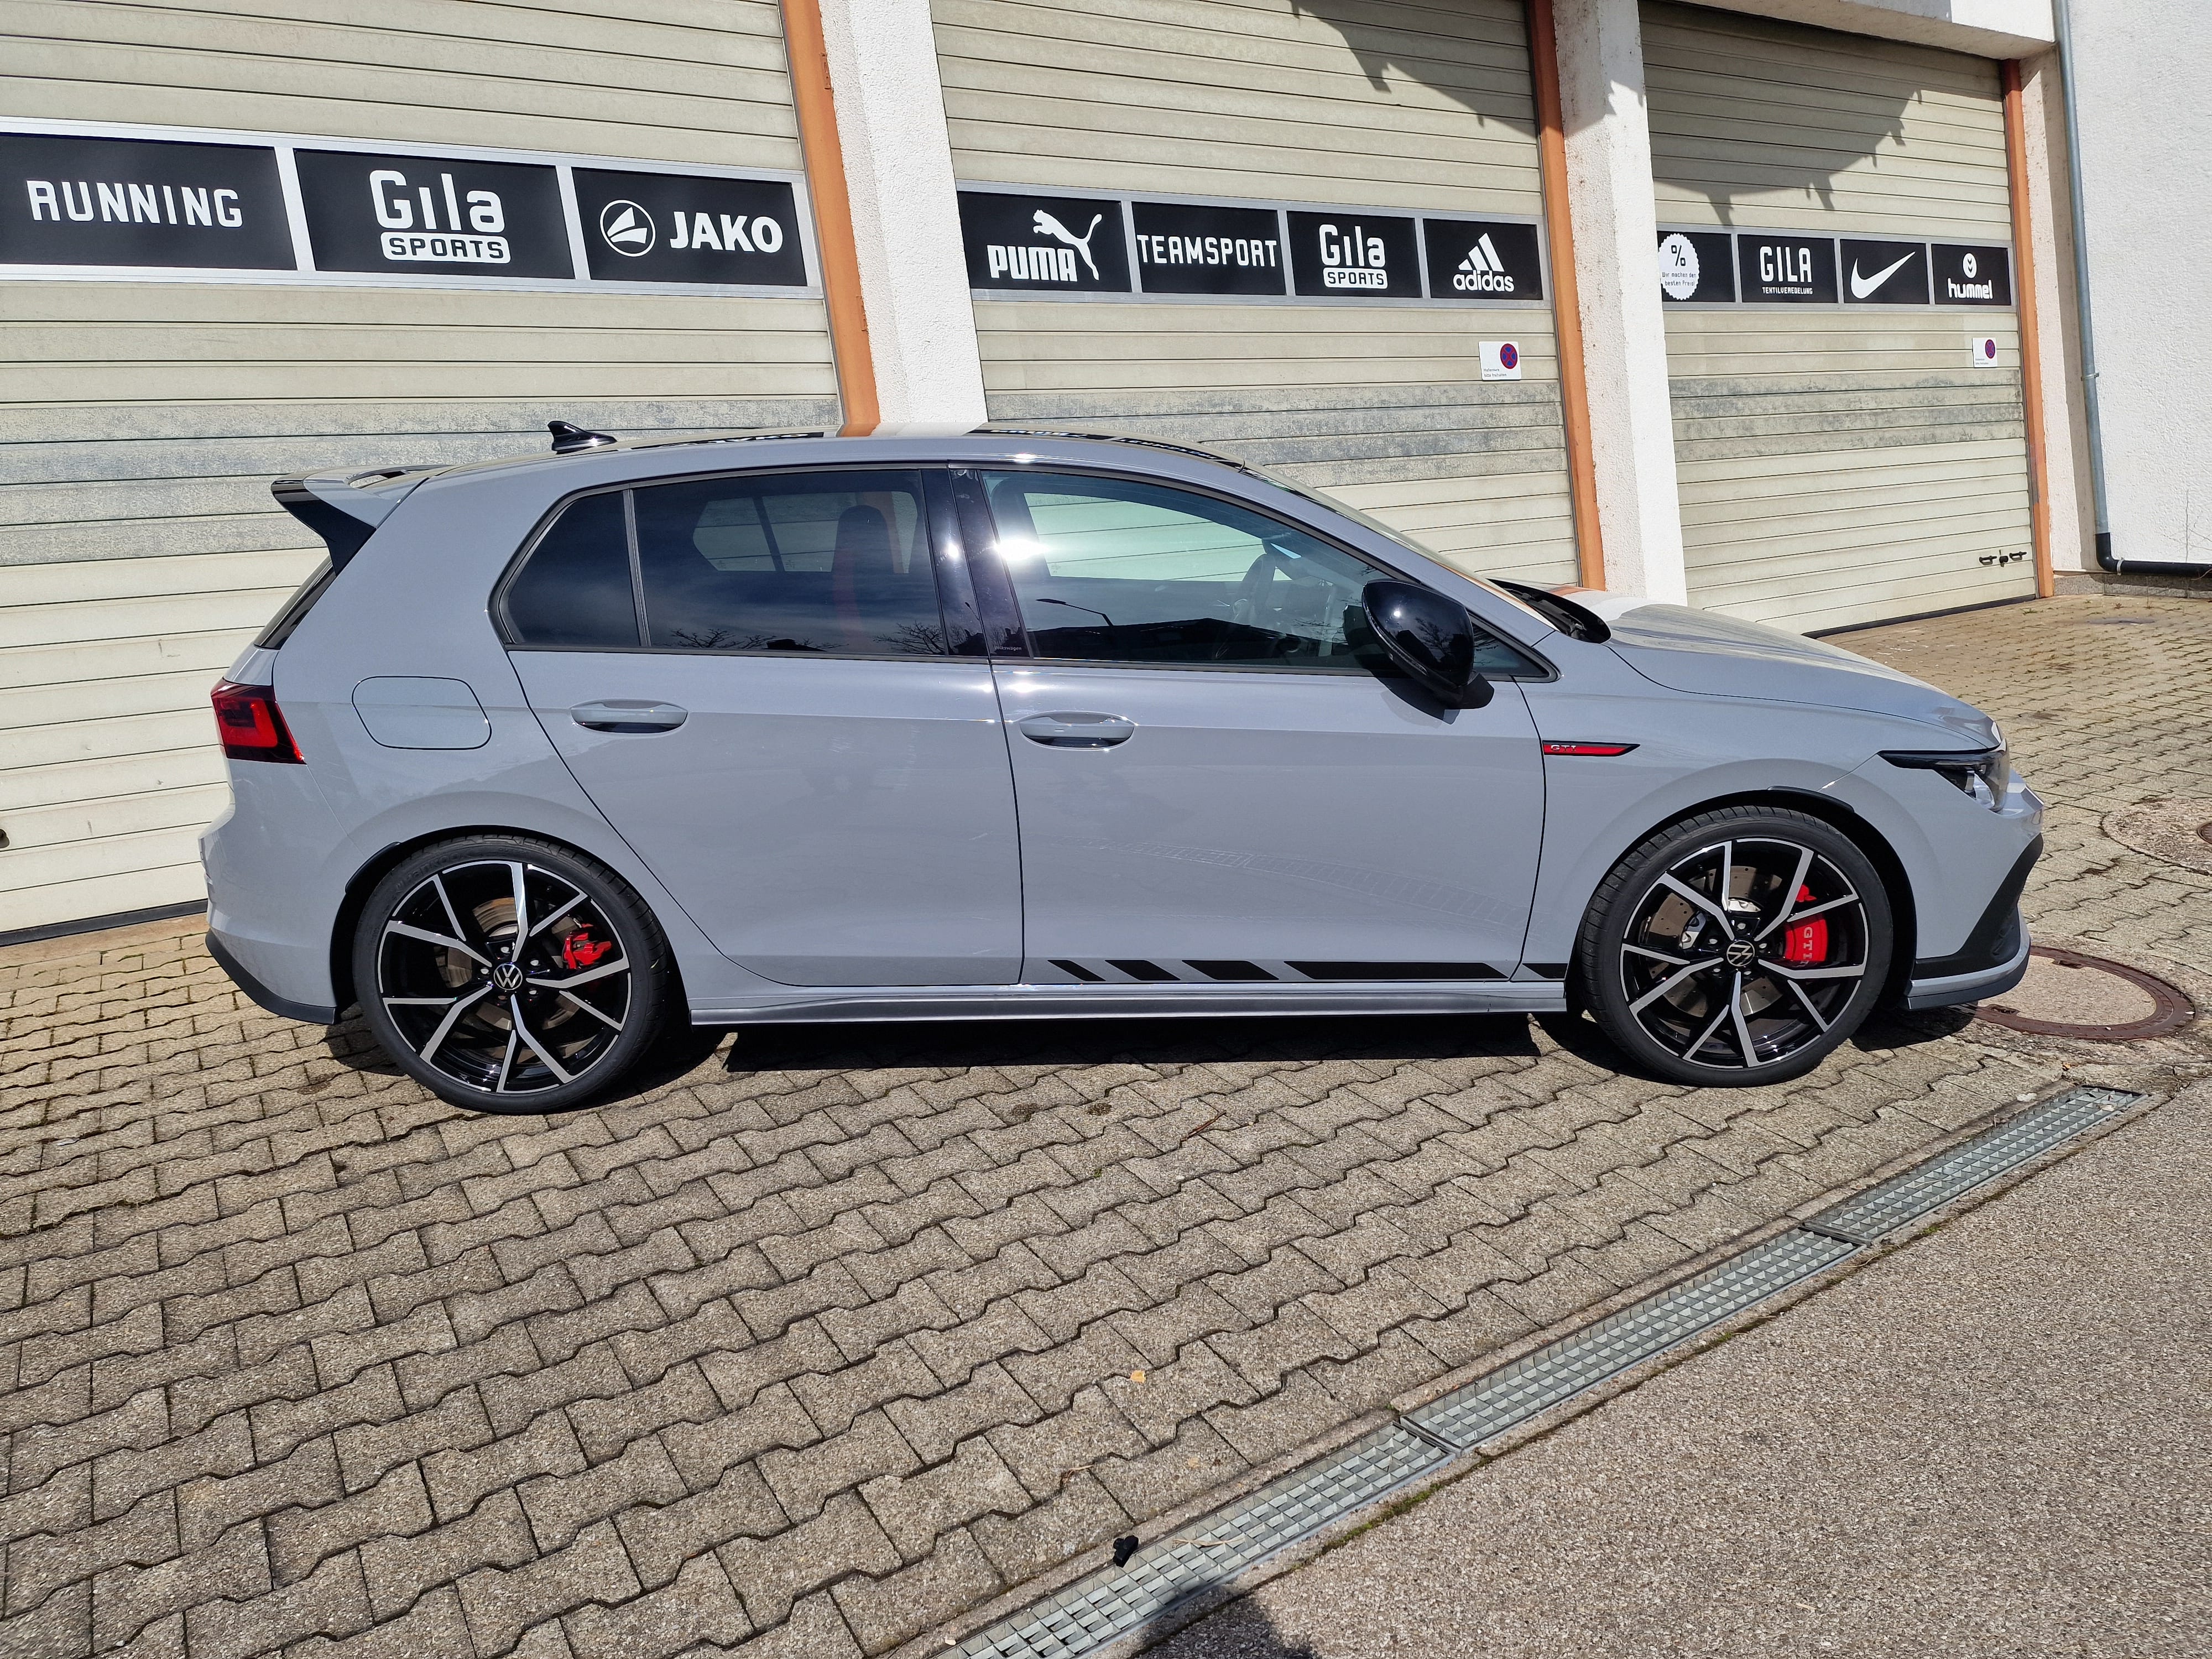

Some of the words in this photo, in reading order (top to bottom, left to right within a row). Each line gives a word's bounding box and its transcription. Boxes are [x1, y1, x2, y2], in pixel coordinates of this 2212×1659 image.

[27, 180, 243, 227] RUNNING
[369, 170, 505, 233] Gila
[389, 237, 504, 259] SPORTS
[670, 211, 783, 253] JAKO
[1319, 224, 1386, 268] Gila
[987, 244, 1078, 282] PUMA
[1137, 234, 1277, 267] TEAMSPORT
[1760, 246, 1812, 283] GILA
[1327, 271, 1384, 286] SPORTS
[1453, 269, 1515, 292] adidas
[1762, 286, 1813, 295] TEXTILVEREDELUNG
[1947, 278, 1993, 299] hummel
[1803, 926, 1813, 959] GTI
